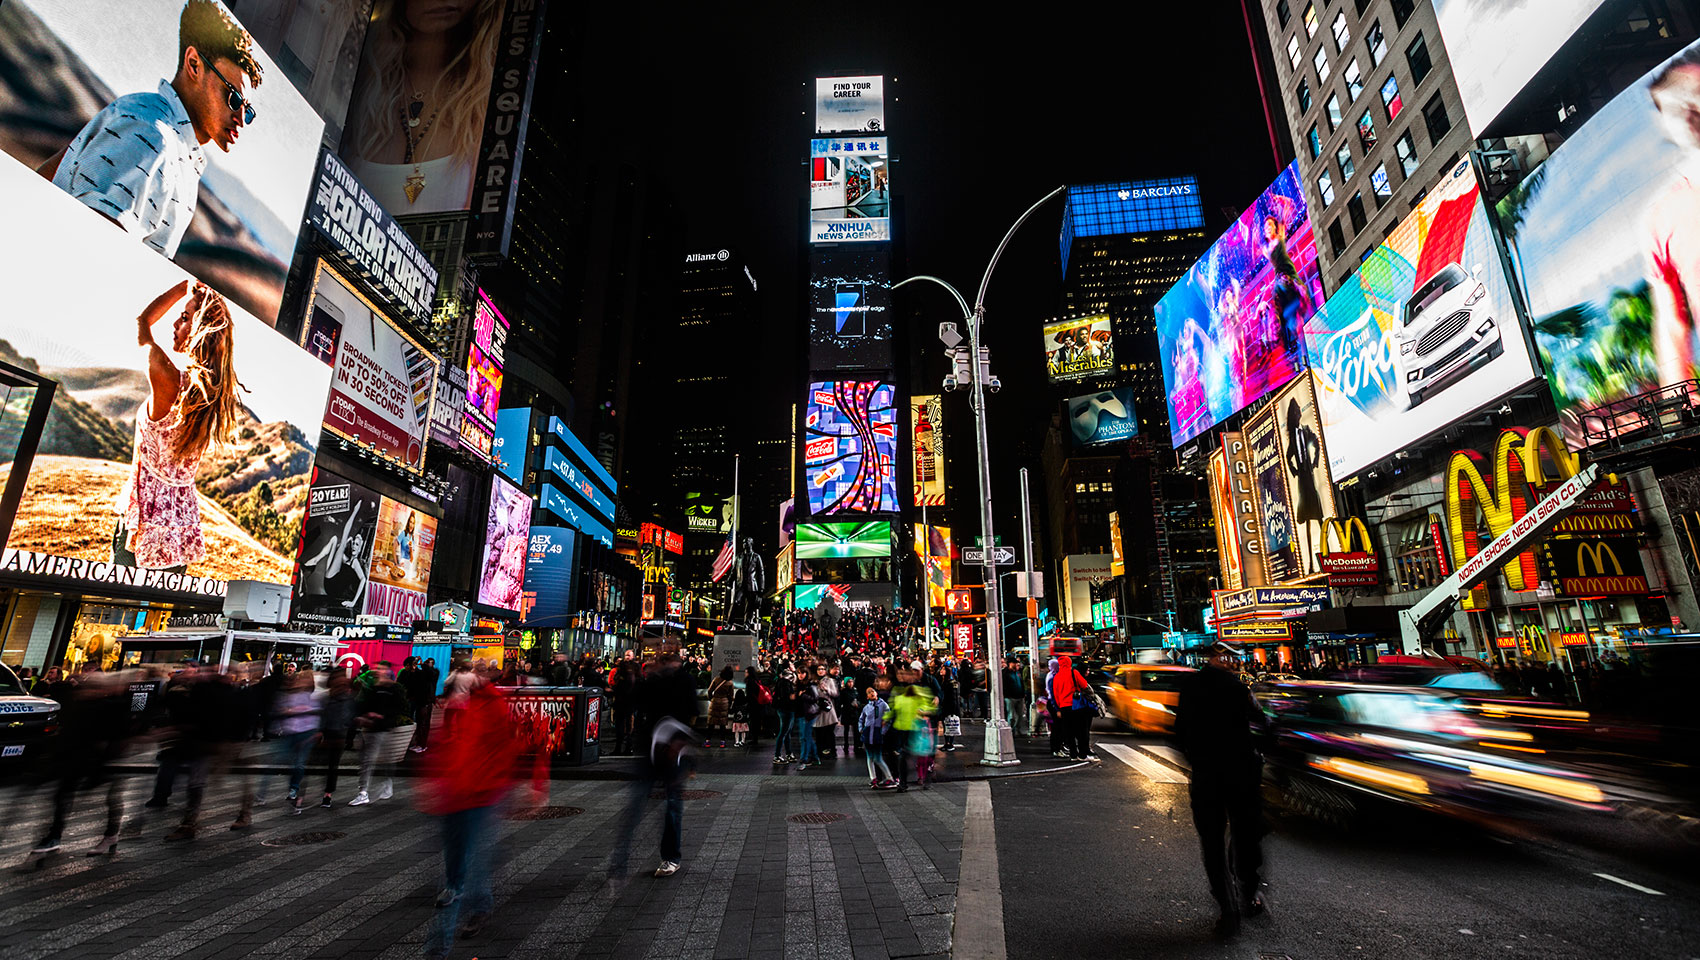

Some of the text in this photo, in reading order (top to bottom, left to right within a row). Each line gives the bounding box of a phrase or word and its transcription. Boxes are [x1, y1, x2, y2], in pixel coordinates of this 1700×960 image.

[834, 82, 871, 91] FIND YOUR
[834, 90, 861, 98] CAREER
[481, 69, 521, 213] SQUARE
[1132, 185, 1191, 199] BARCLAYS
[325, 153, 439, 286] CYNTHIA ERIVO JENNIFER HUDSON
[827, 222, 873, 232] XINHUA
[476, 231, 495, 239] NYC
[817, 231, 885, 240] NEWS AGENCY
[316, 174, 436, 313] THE COLOR PURPLE
[331, 226, 371, 268] MIRACLE
[371, 260, 383, 281] ON
[685, 253, 717, 262] Allianz
[317, 330, 334, 346] TODAY
[1071, 353, 1087, 362] Les
[343, 341, 409, 393] BROADWAY TICKETS
[341, 355, 407, 406] UP TO 50% OFF
[337, 369, 405, 420] IN 30 SECONDS
[335, 395, 356, 412] TODAY
[338, 406, 350, 420] TIX
[363, 419, 382, 439] Broadway
[381, 428, 393, 444] Ticket
[392, 435, 400, 448] App
[1098, 422, 1135, 433] PHANTOM
[493, 438, 504, 447] 49
[806, 441, 834, 457] Coca-Cola
[312, 488, 349, 502] 20 YEARS
[1231, 441, 1260, 554] PALACE
[531, 535, 551, 544] AEX
[1458, 483, 1579, 582] NORTH SHORE NEON SIGN CO.
[530, 544, 562, 554] 437.49
[1323, 558, 1376, 566] McDonald's
[5, 551, 228, 597] AMERICAN EAGLE OU
[367, 582, 426, 628] WAITRESS
[297, 613, 355, 624] CHICAGOTHEMUSICAL.COM
[346, 627, 376, 638] NYC
[958, 626, 970, 649] tkts
[541, 701, 571, 723] BOYS
